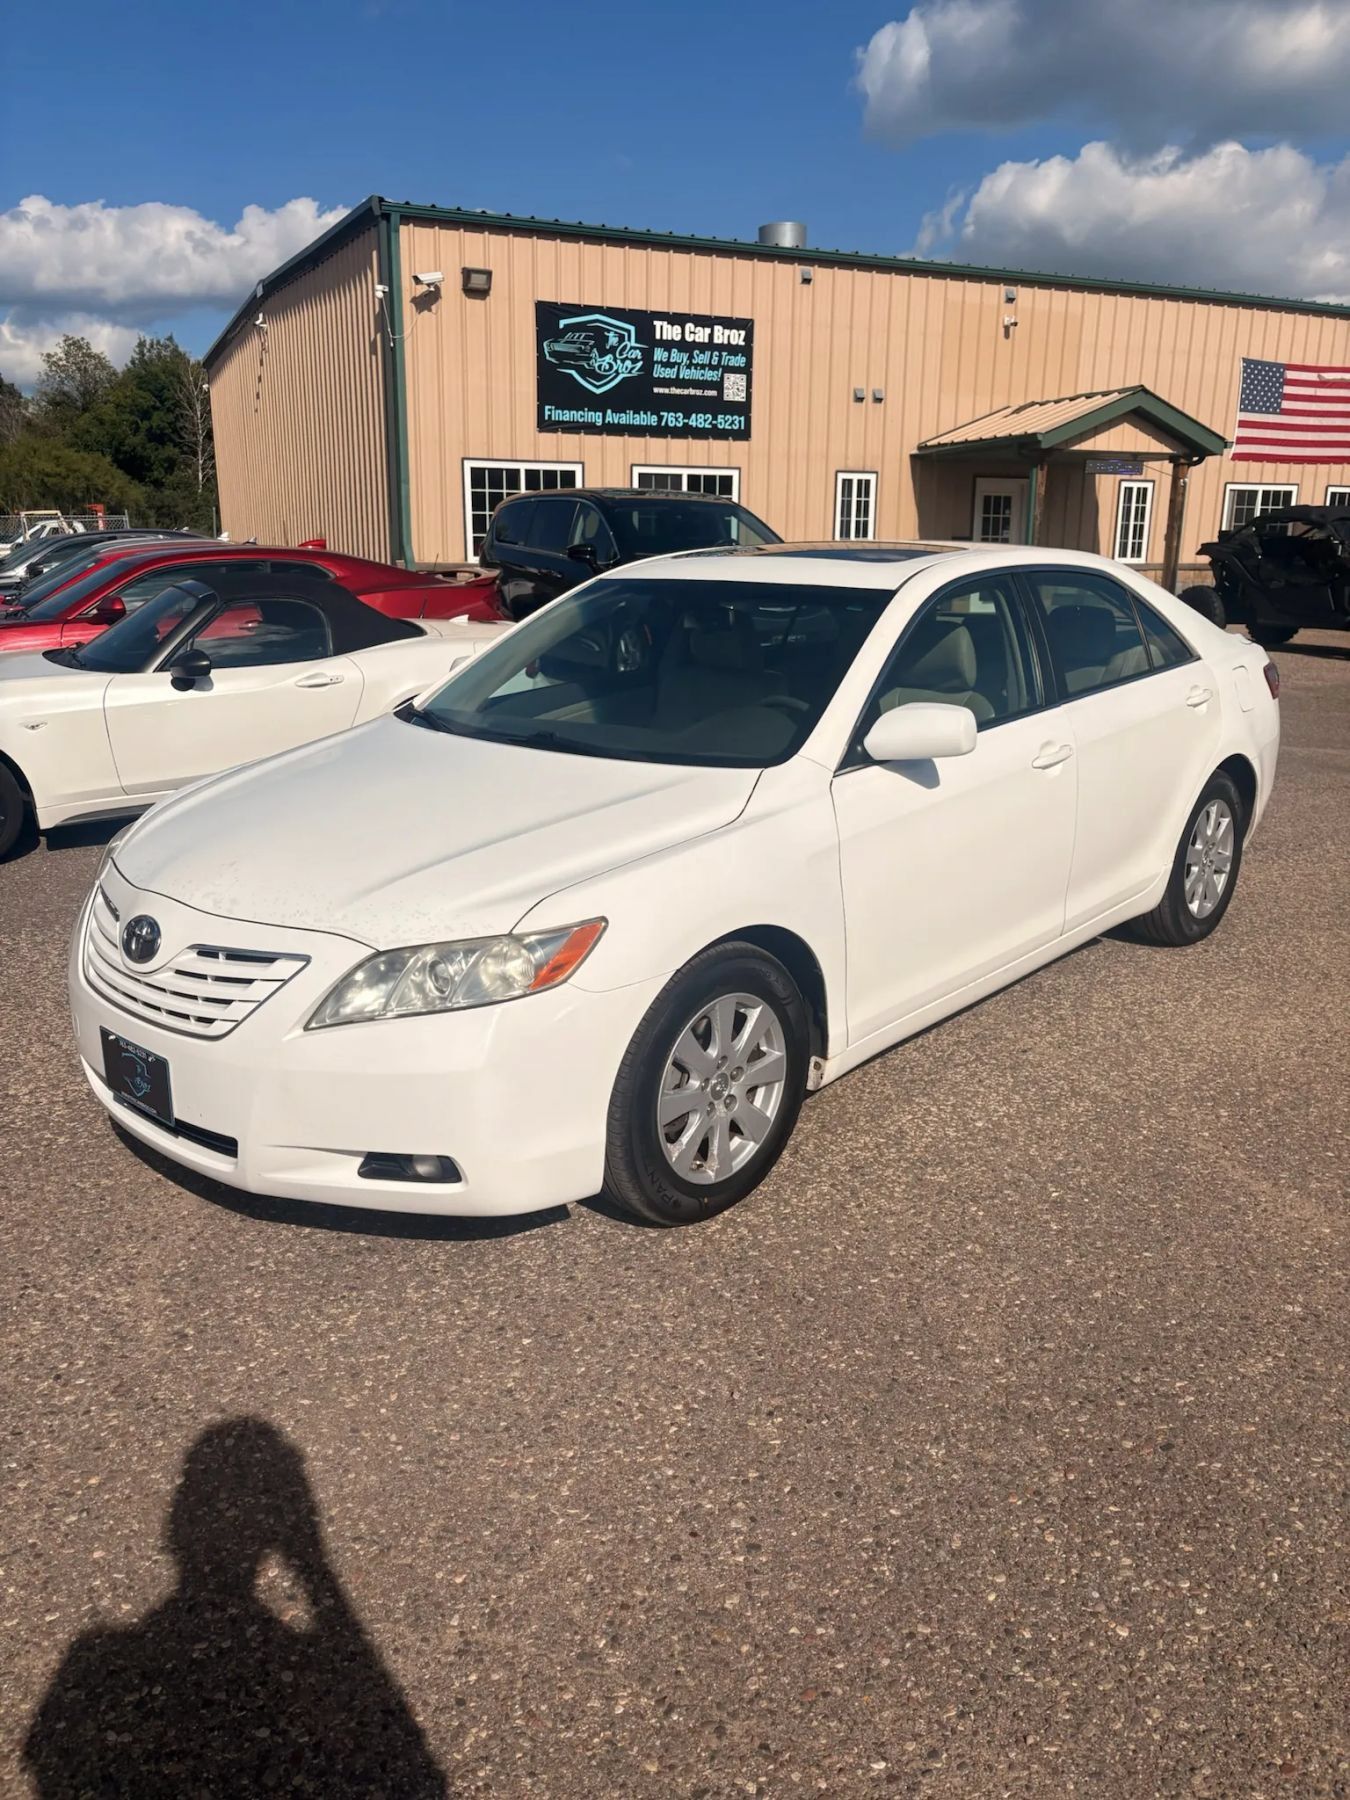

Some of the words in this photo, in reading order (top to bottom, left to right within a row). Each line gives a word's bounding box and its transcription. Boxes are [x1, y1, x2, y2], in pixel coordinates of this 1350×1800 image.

[653, 320, 682, 341] The
[684, 322, 711, 343] Car
[713, 325, 746, 346] Broz
[615, 341, 643, 359] Car
[653, 347, 669, 362] We
[669, 348, 690, 366] Buy,
[692, 350, 711, 365] Sell
[711, 351, 719, 365] &
[721, 352, 747, 367] Trade
[595, 354, 645, 375] Broz
[653, 364, 678, 379] Used
[679, 365, 722, 381] Vehicles!
[653, 386, 718, 397] www.thecarbroz.com
[544, 405, 603, 426] Financing
[605, 409, 658, 426] Available
[659, 411, 745, 430] 763-482-5231
